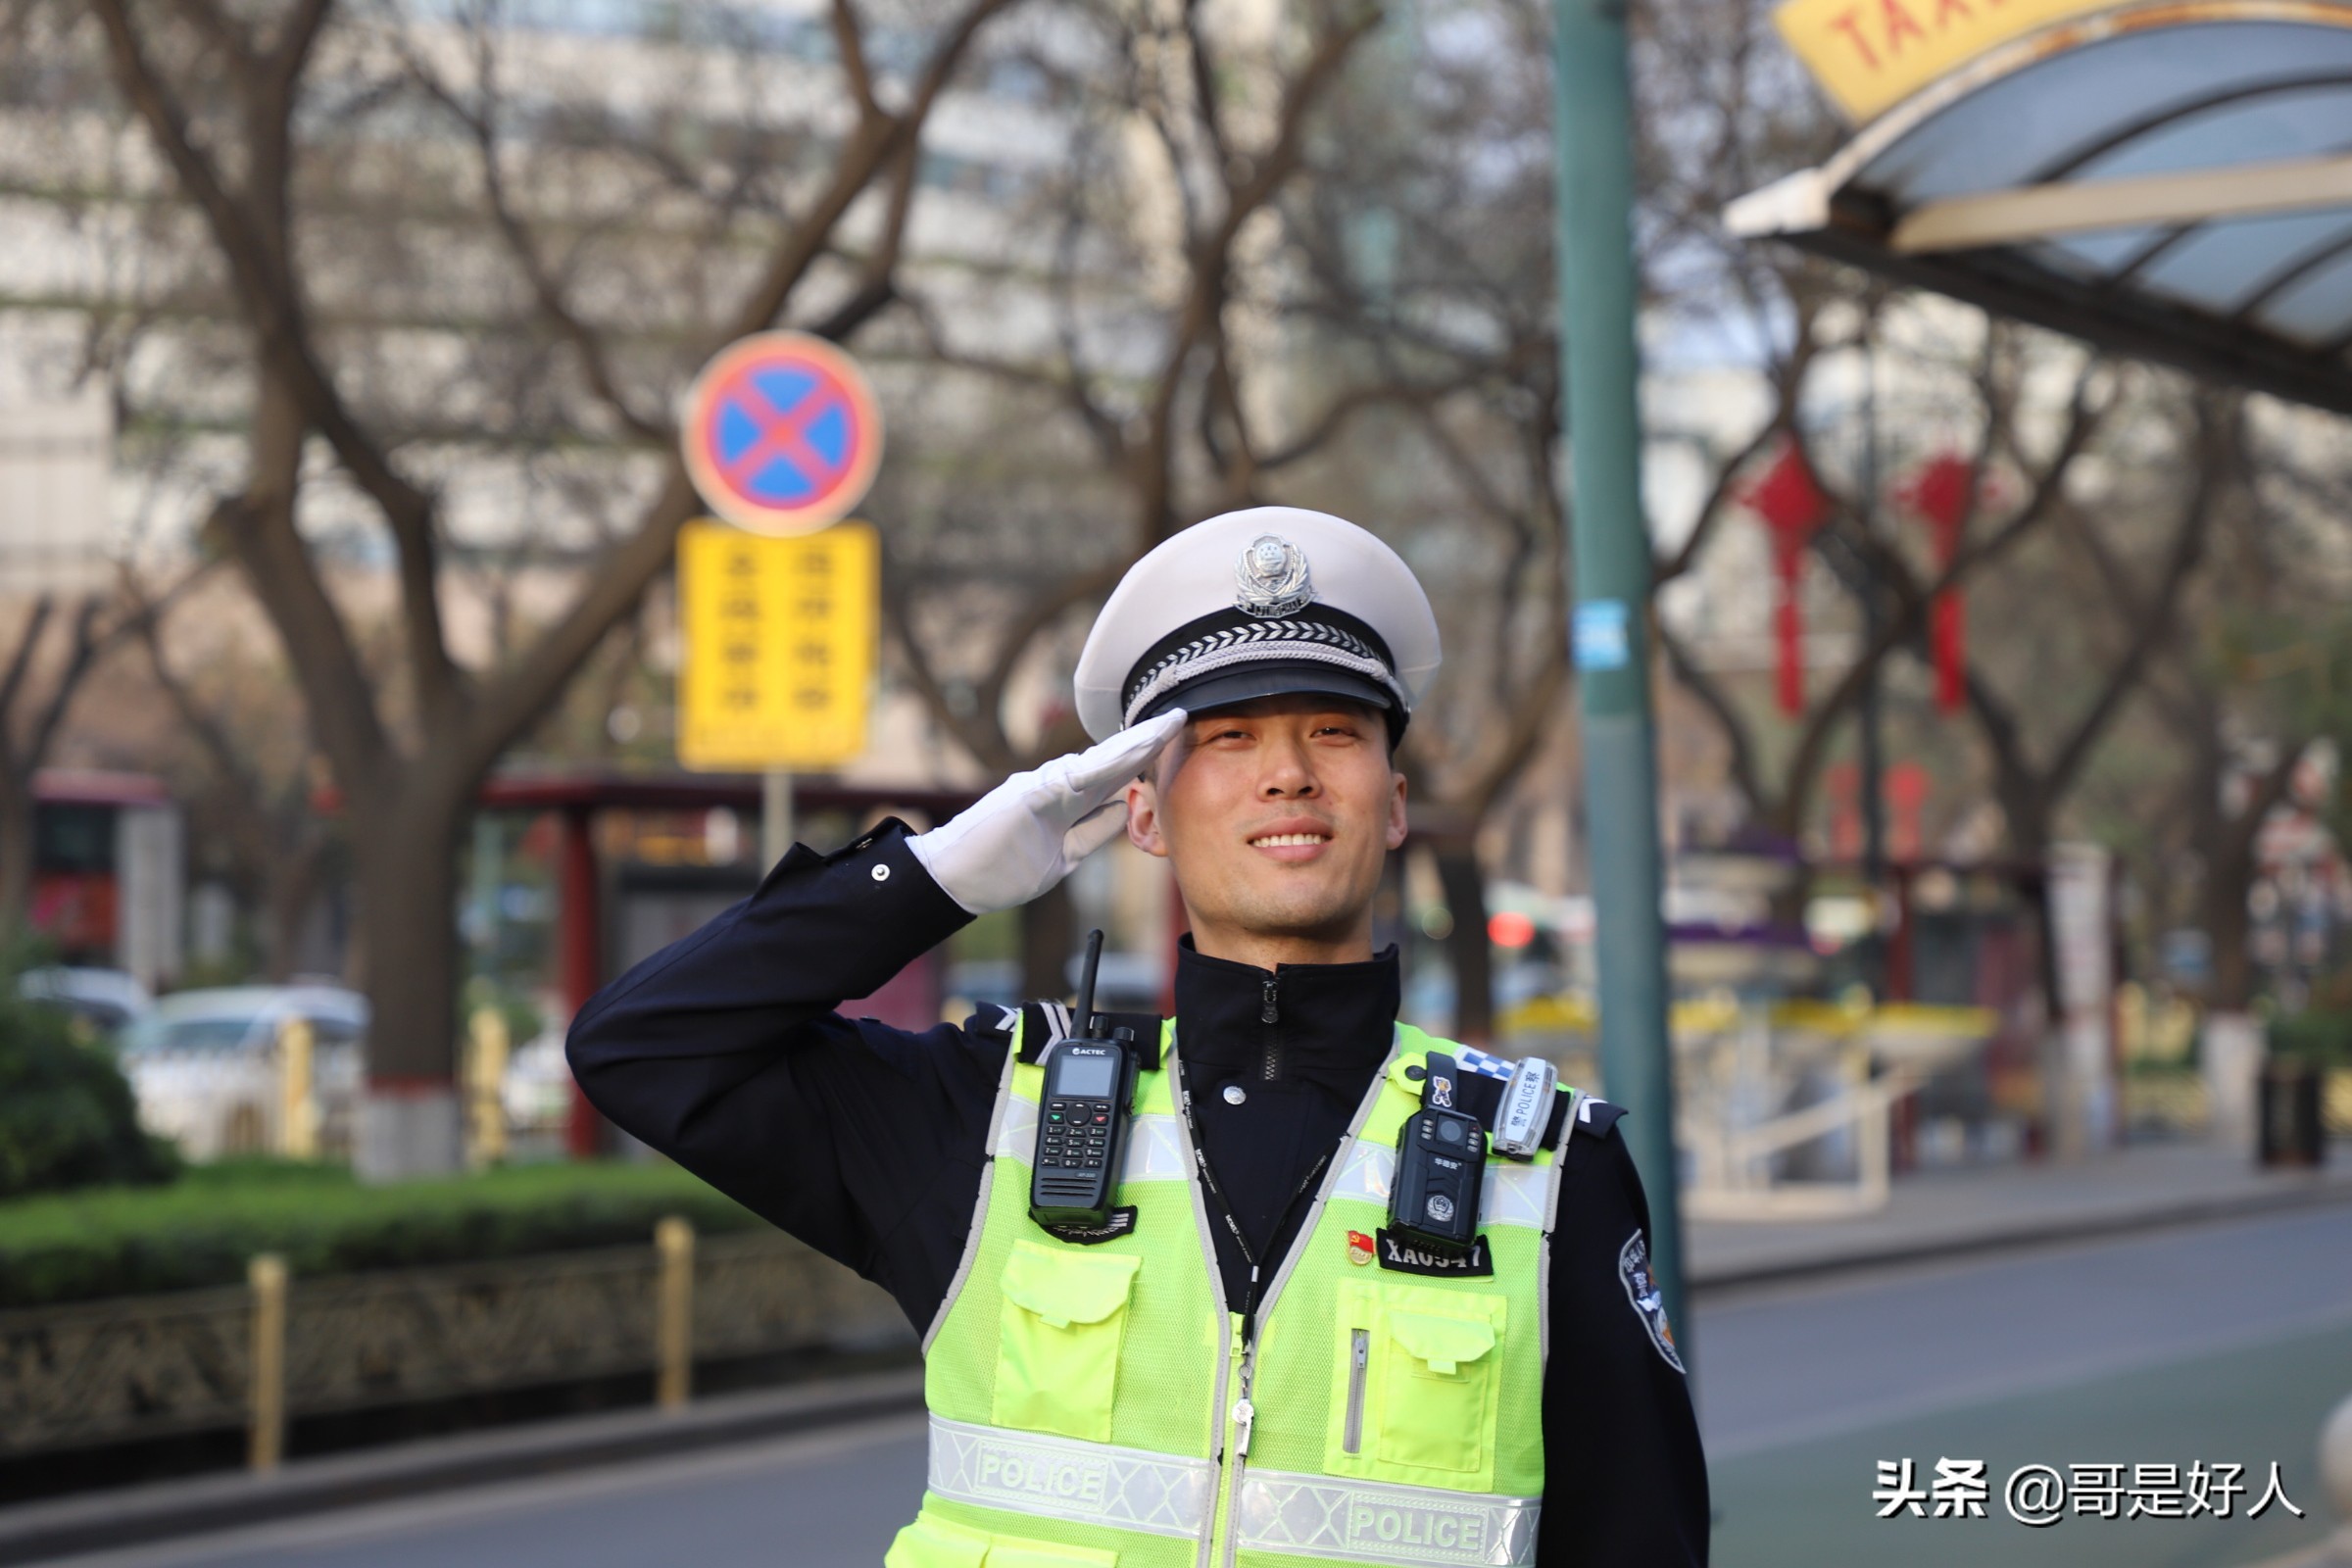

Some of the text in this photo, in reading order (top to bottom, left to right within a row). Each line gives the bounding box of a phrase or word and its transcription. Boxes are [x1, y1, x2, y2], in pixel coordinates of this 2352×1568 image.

[1830, 0, 2005, 72] TA
[980, 1452, 1101, 1500] POLICE
[1350, 1504, 1482, 1550] POLICE
